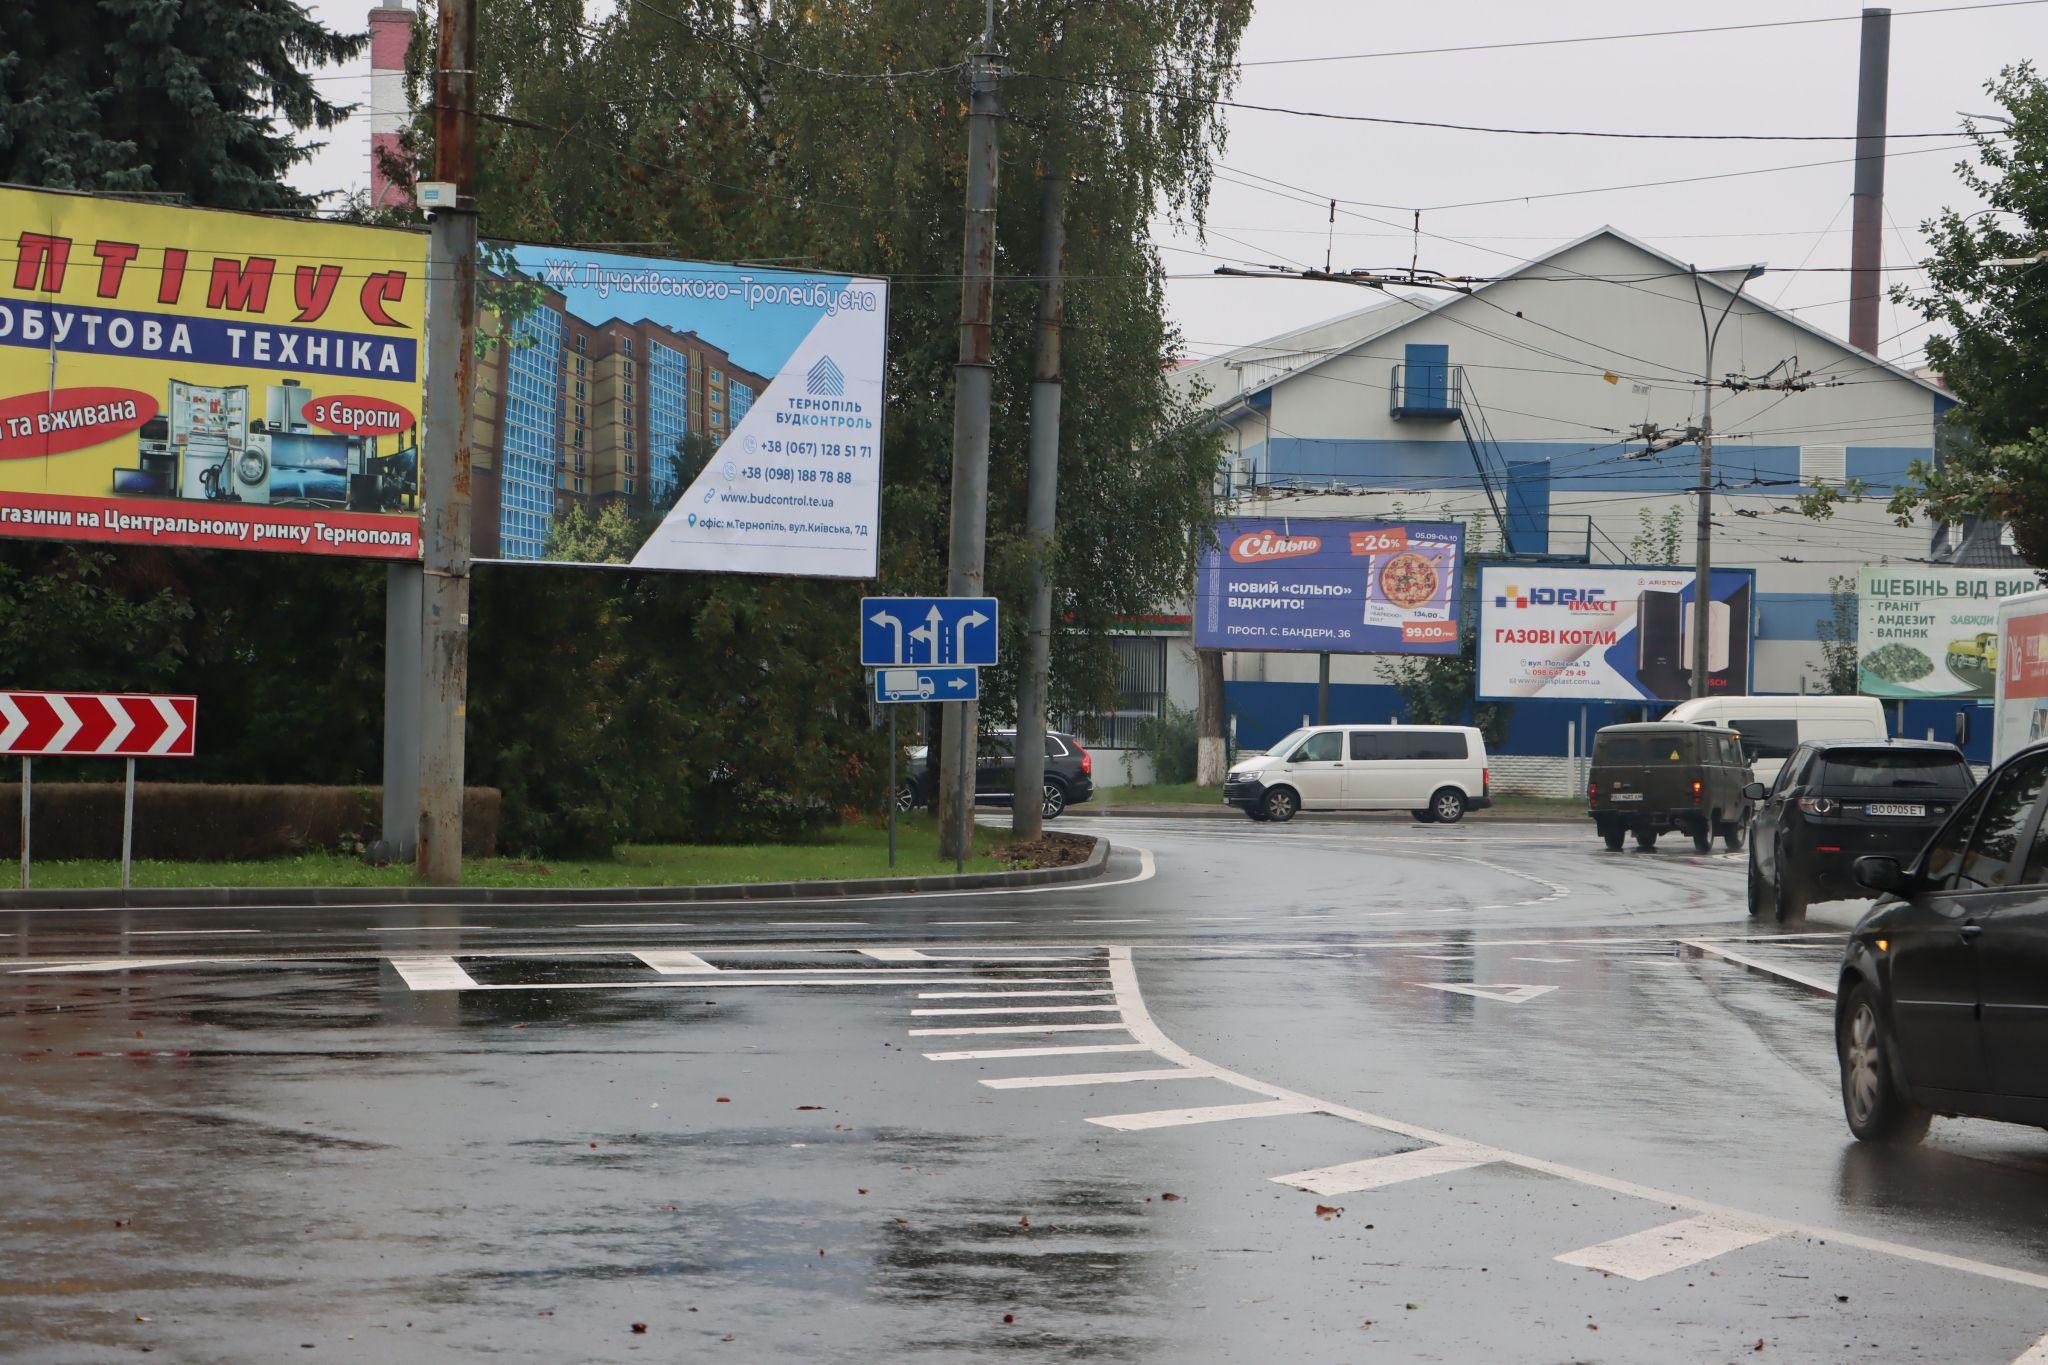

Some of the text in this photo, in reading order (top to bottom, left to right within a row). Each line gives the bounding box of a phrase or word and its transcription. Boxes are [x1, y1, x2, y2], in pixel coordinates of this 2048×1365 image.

[13, 231, 413, 329] ПТІМУС
[544, 259, 578, 287] ЖК
[227, 327, 400, 374] ТЕХНІКА
[788, 397, 862, 413] ТЕРНОПІЛЬ
[7, 417, 32, 437] та
[39, 399, 136, 432] вживана
[315, 401, 400, 431] з Європи
[776, 412, 872, 429] БУДКОНТРОЛЬ
[761, 440, 871, 458] +38 (067) 128 51 71
[741, 467, 851, 484] +38 (098) 188 78 88
[721, 492, 834, 508] www.budcontrol.te.ua
[76, 511, 99, 527] на
[104, 510, 249, 540] Центральному
[254, 522, 310, 541] ринку
[314, 522, 412, 546] Тернополя
[700, 518, 868, 536] офіс: м.Тернопіль, вул.Київська, 7Д
[1415, 532, 1457, 542] 05.09-04.10
[1239, 534, 1317, 558] Сільпо
[1228, 582, 1352, 595] НОВИЙ «СІЛЬПО»
[1871, 579, 2041, 599] ЩЕБІНЬ ВІД ВИР
[1228, 598, 1304, 610] ВІДКРИТО!
[1569, 600, 1617, 611] ПЛАСТ
[1878, 602, 1920, 612] ГРАНІТ
[1877, 615, 1936, 626] АНДЕЗИТ
[1950, 615, 1994, 626] ЗАВЖДИ
[1227, 626, 1350, 638] ПРОСП. С. БАНДЕРИ, 36
[1406, 628, 1441, 637] 99,00
[1496, 629, 1617, 645] ГАЗОВІ КОТЛИ
[1877, 629, 1928, 638] ВАПНЯК
